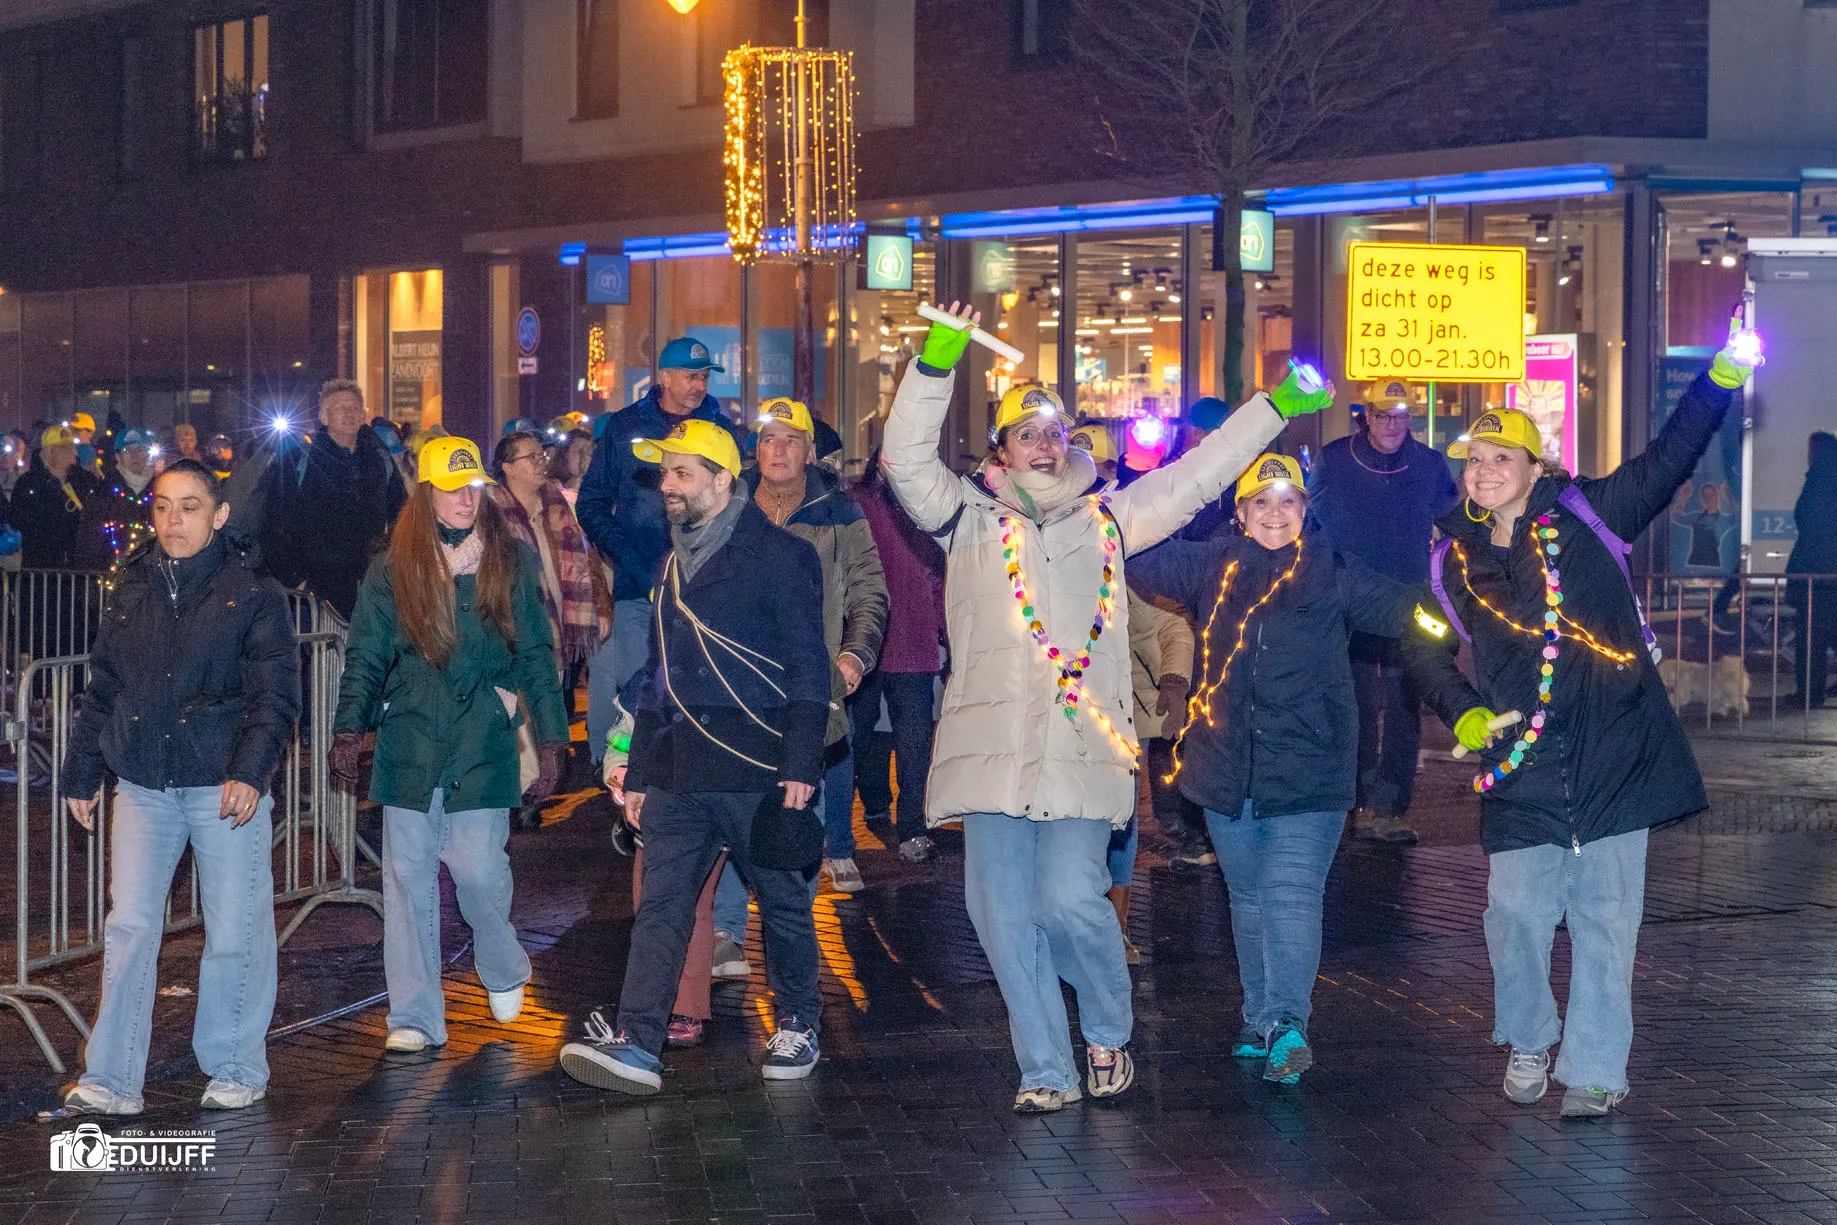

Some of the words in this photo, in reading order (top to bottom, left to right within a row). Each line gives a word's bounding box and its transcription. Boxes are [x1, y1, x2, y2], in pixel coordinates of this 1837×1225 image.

[1362, 258, 1415, 277] deze
[1427, 264, 1469, 286] weg
[1479, 261, 1496, 281] is
[1362, 288, 1417, 308] dicht
[1427, 294, 1452, 312] op
[1361, 322, 1386, 337] za
[1396, 319, 1417, 338] 31
[1427, 320, 1467, 344] jan.
[1360, 348, 1510, 370] 13.00-21.30h
